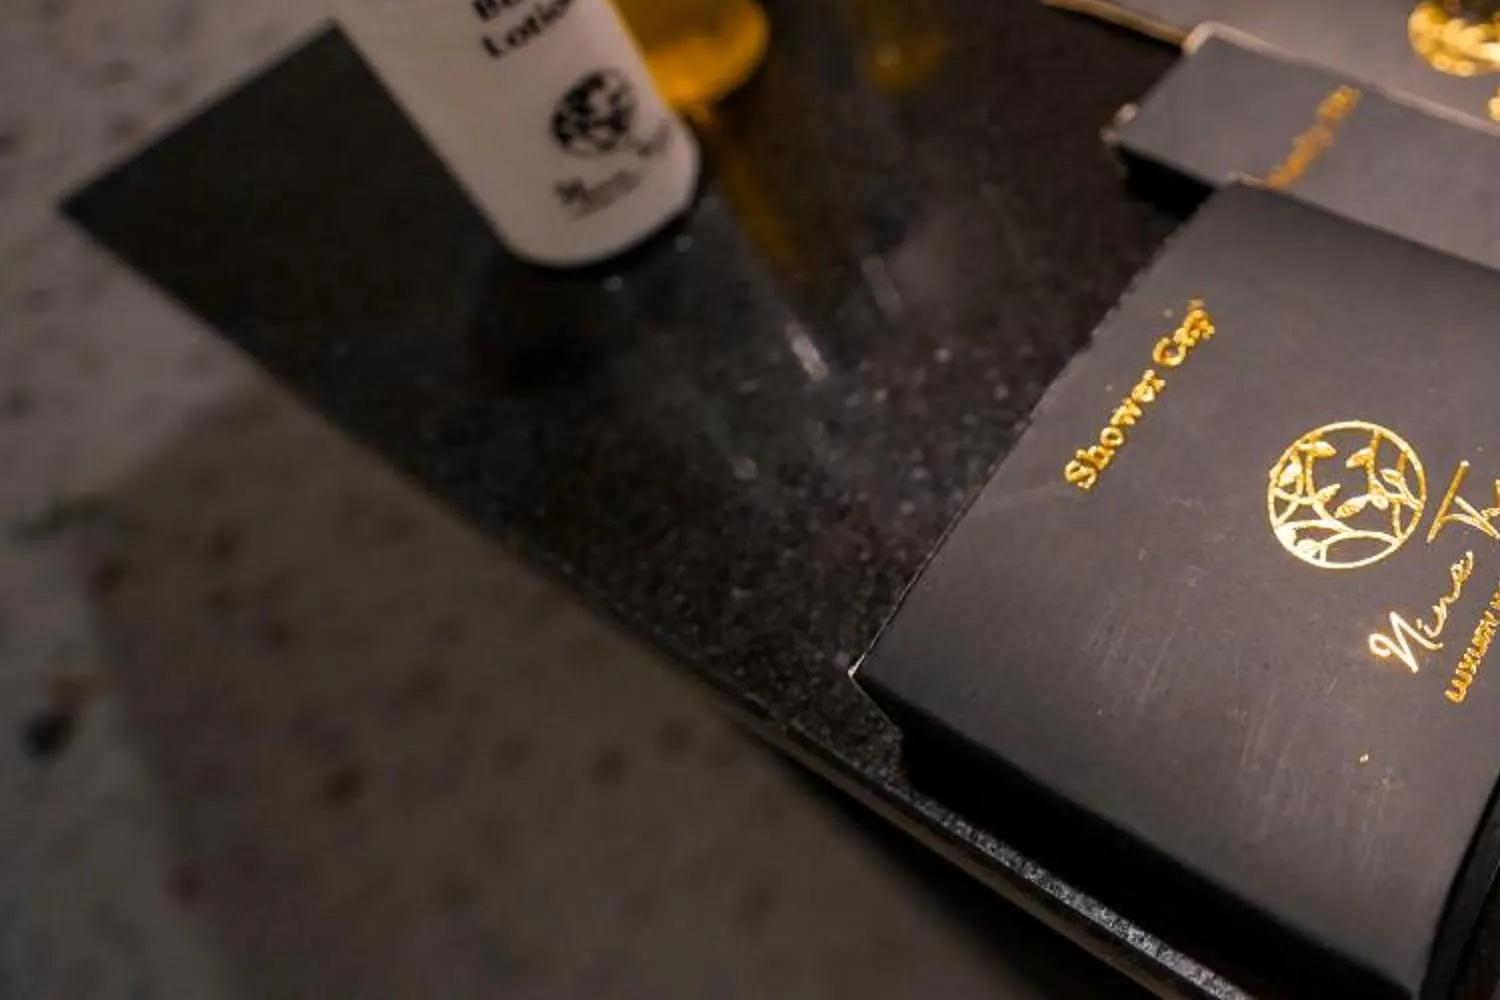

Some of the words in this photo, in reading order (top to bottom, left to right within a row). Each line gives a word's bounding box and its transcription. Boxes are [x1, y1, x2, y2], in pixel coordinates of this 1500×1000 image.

[1063, 368, 1167, 491] Shower
[1368, 549, 1473, 674] Nine
[1444, 609, 1500, 704] LUXURY
